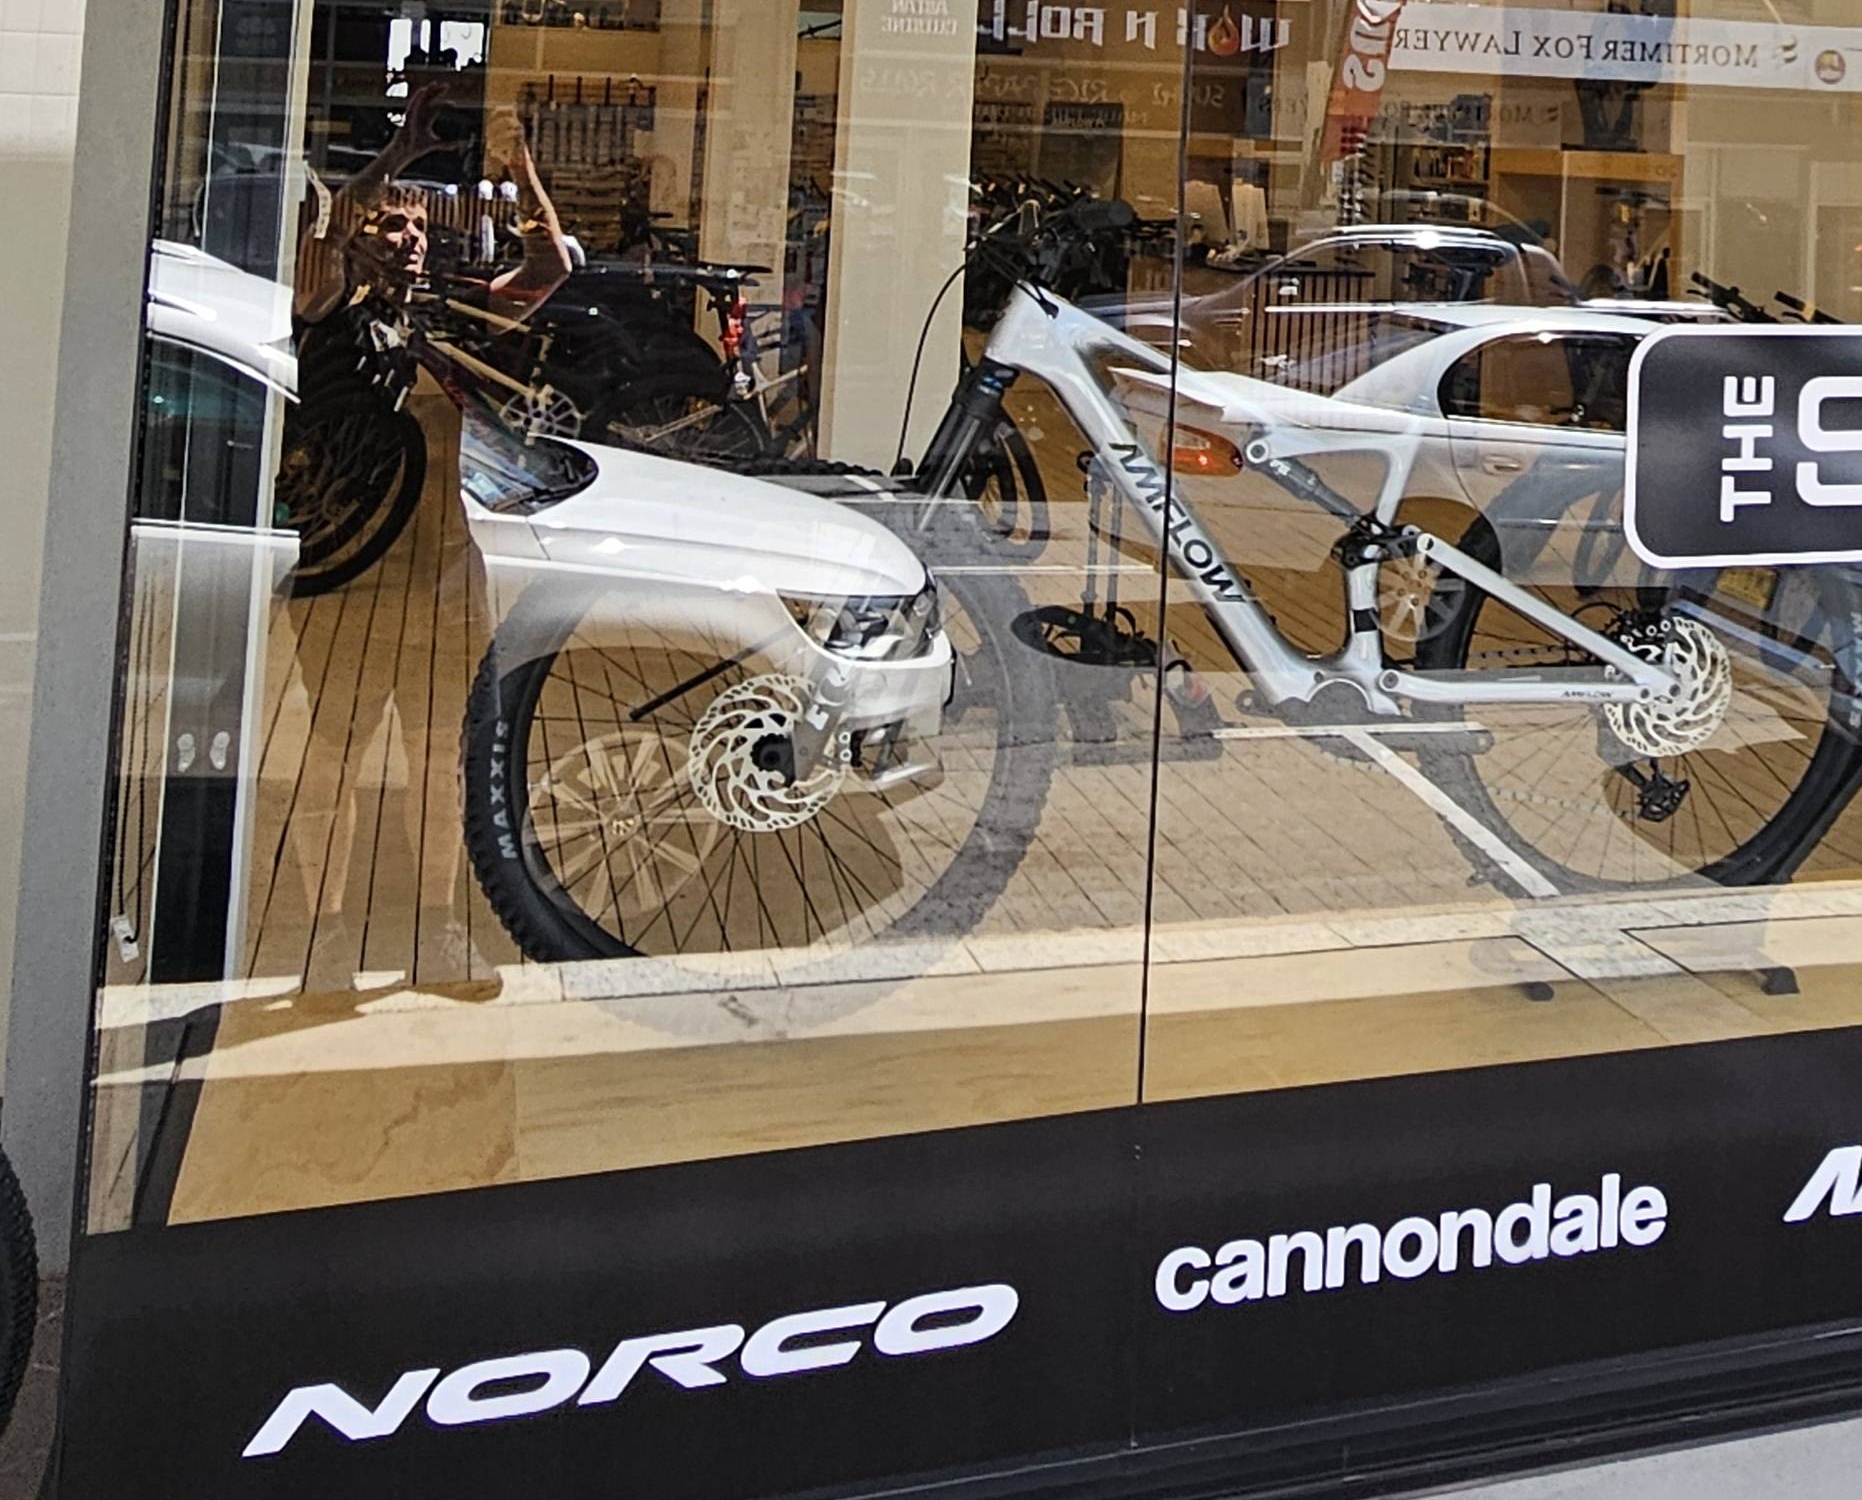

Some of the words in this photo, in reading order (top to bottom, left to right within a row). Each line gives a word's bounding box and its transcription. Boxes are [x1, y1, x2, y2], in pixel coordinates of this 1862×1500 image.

[1719, 375, 1775, 522] THE
[1108, 441, 1246, 604] AMFLOW
[489, 720, 519, 860] MAXXIS
[1154, 1171, 1670, 1313] cannondale
[241, 1283, 1020, 1458] NORCO
